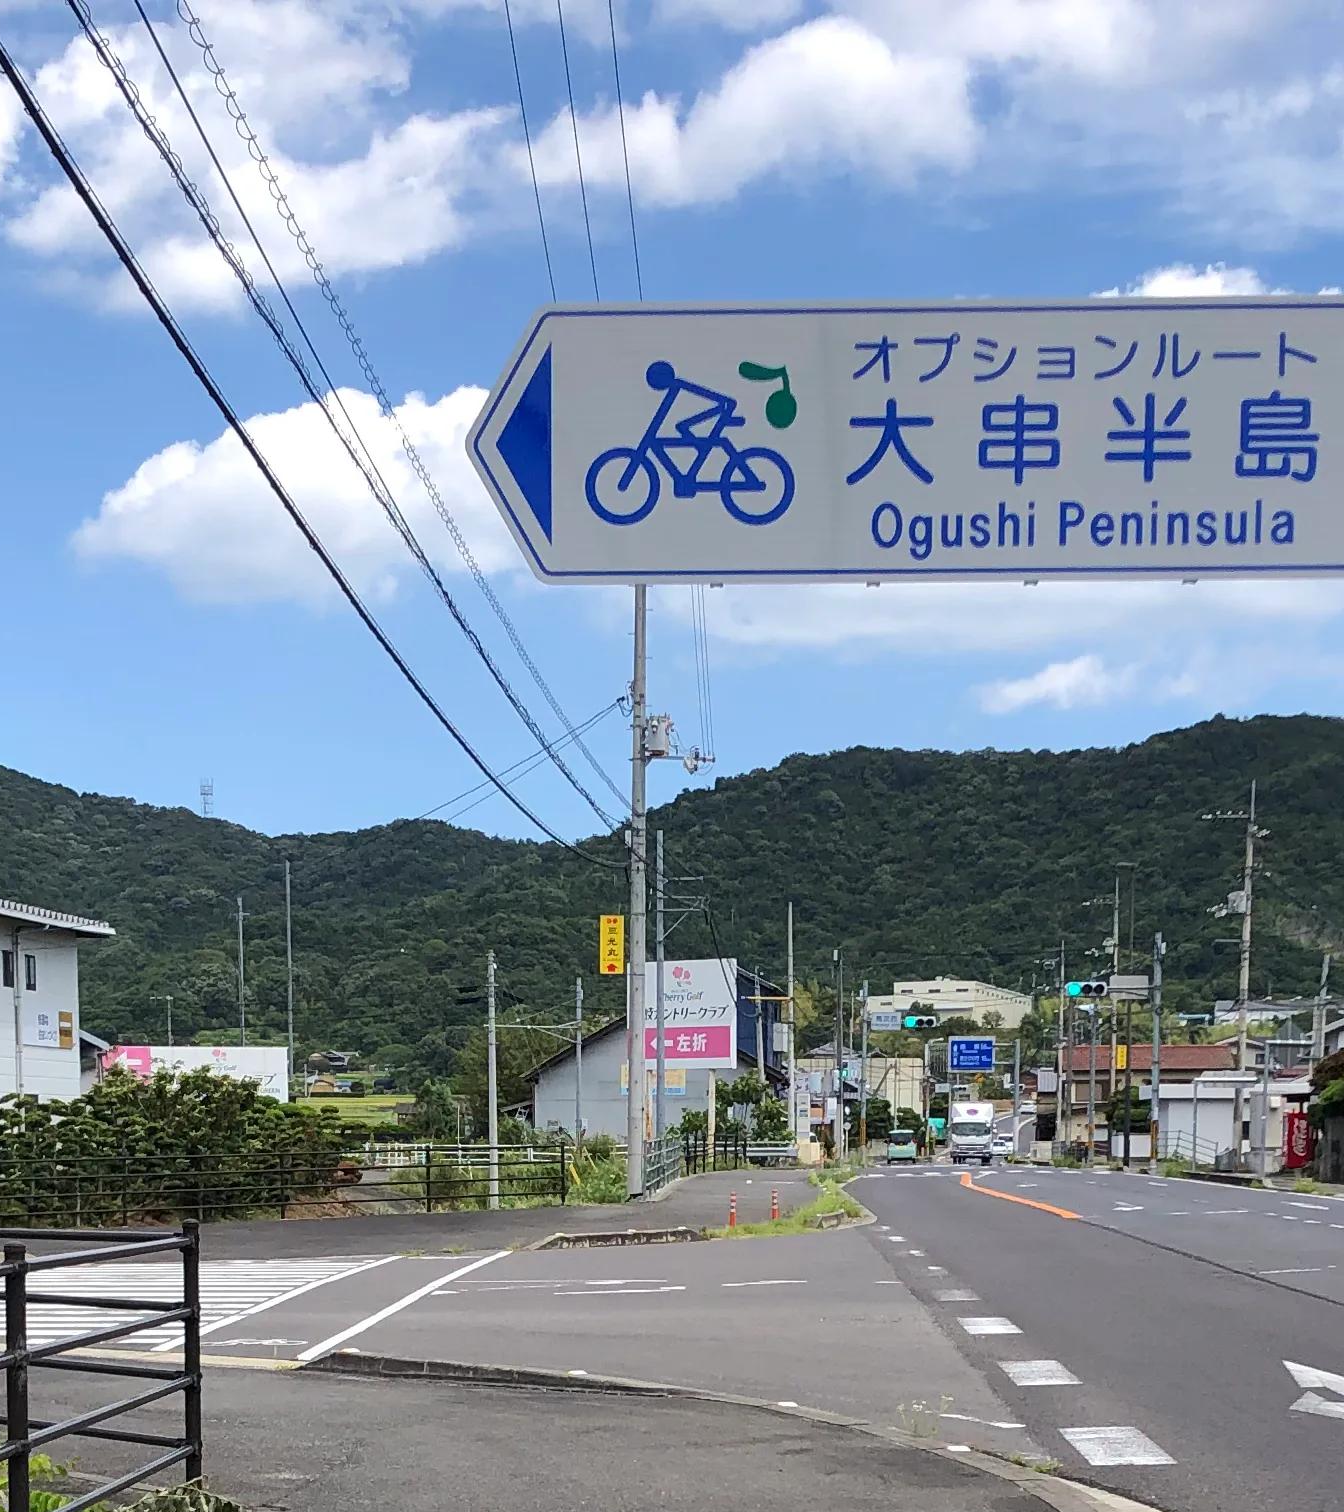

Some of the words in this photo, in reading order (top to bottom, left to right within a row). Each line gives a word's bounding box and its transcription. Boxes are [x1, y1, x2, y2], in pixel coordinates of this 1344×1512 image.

[851, 331, 1318, 382] オプションルート
[845, 391, 1321, 486] 大串半島
[870, 501, 1037, 560] Ogushi
[1059, 500, 1296, 547] Peninsula
[676, 1033, 707, 1052] 左折
